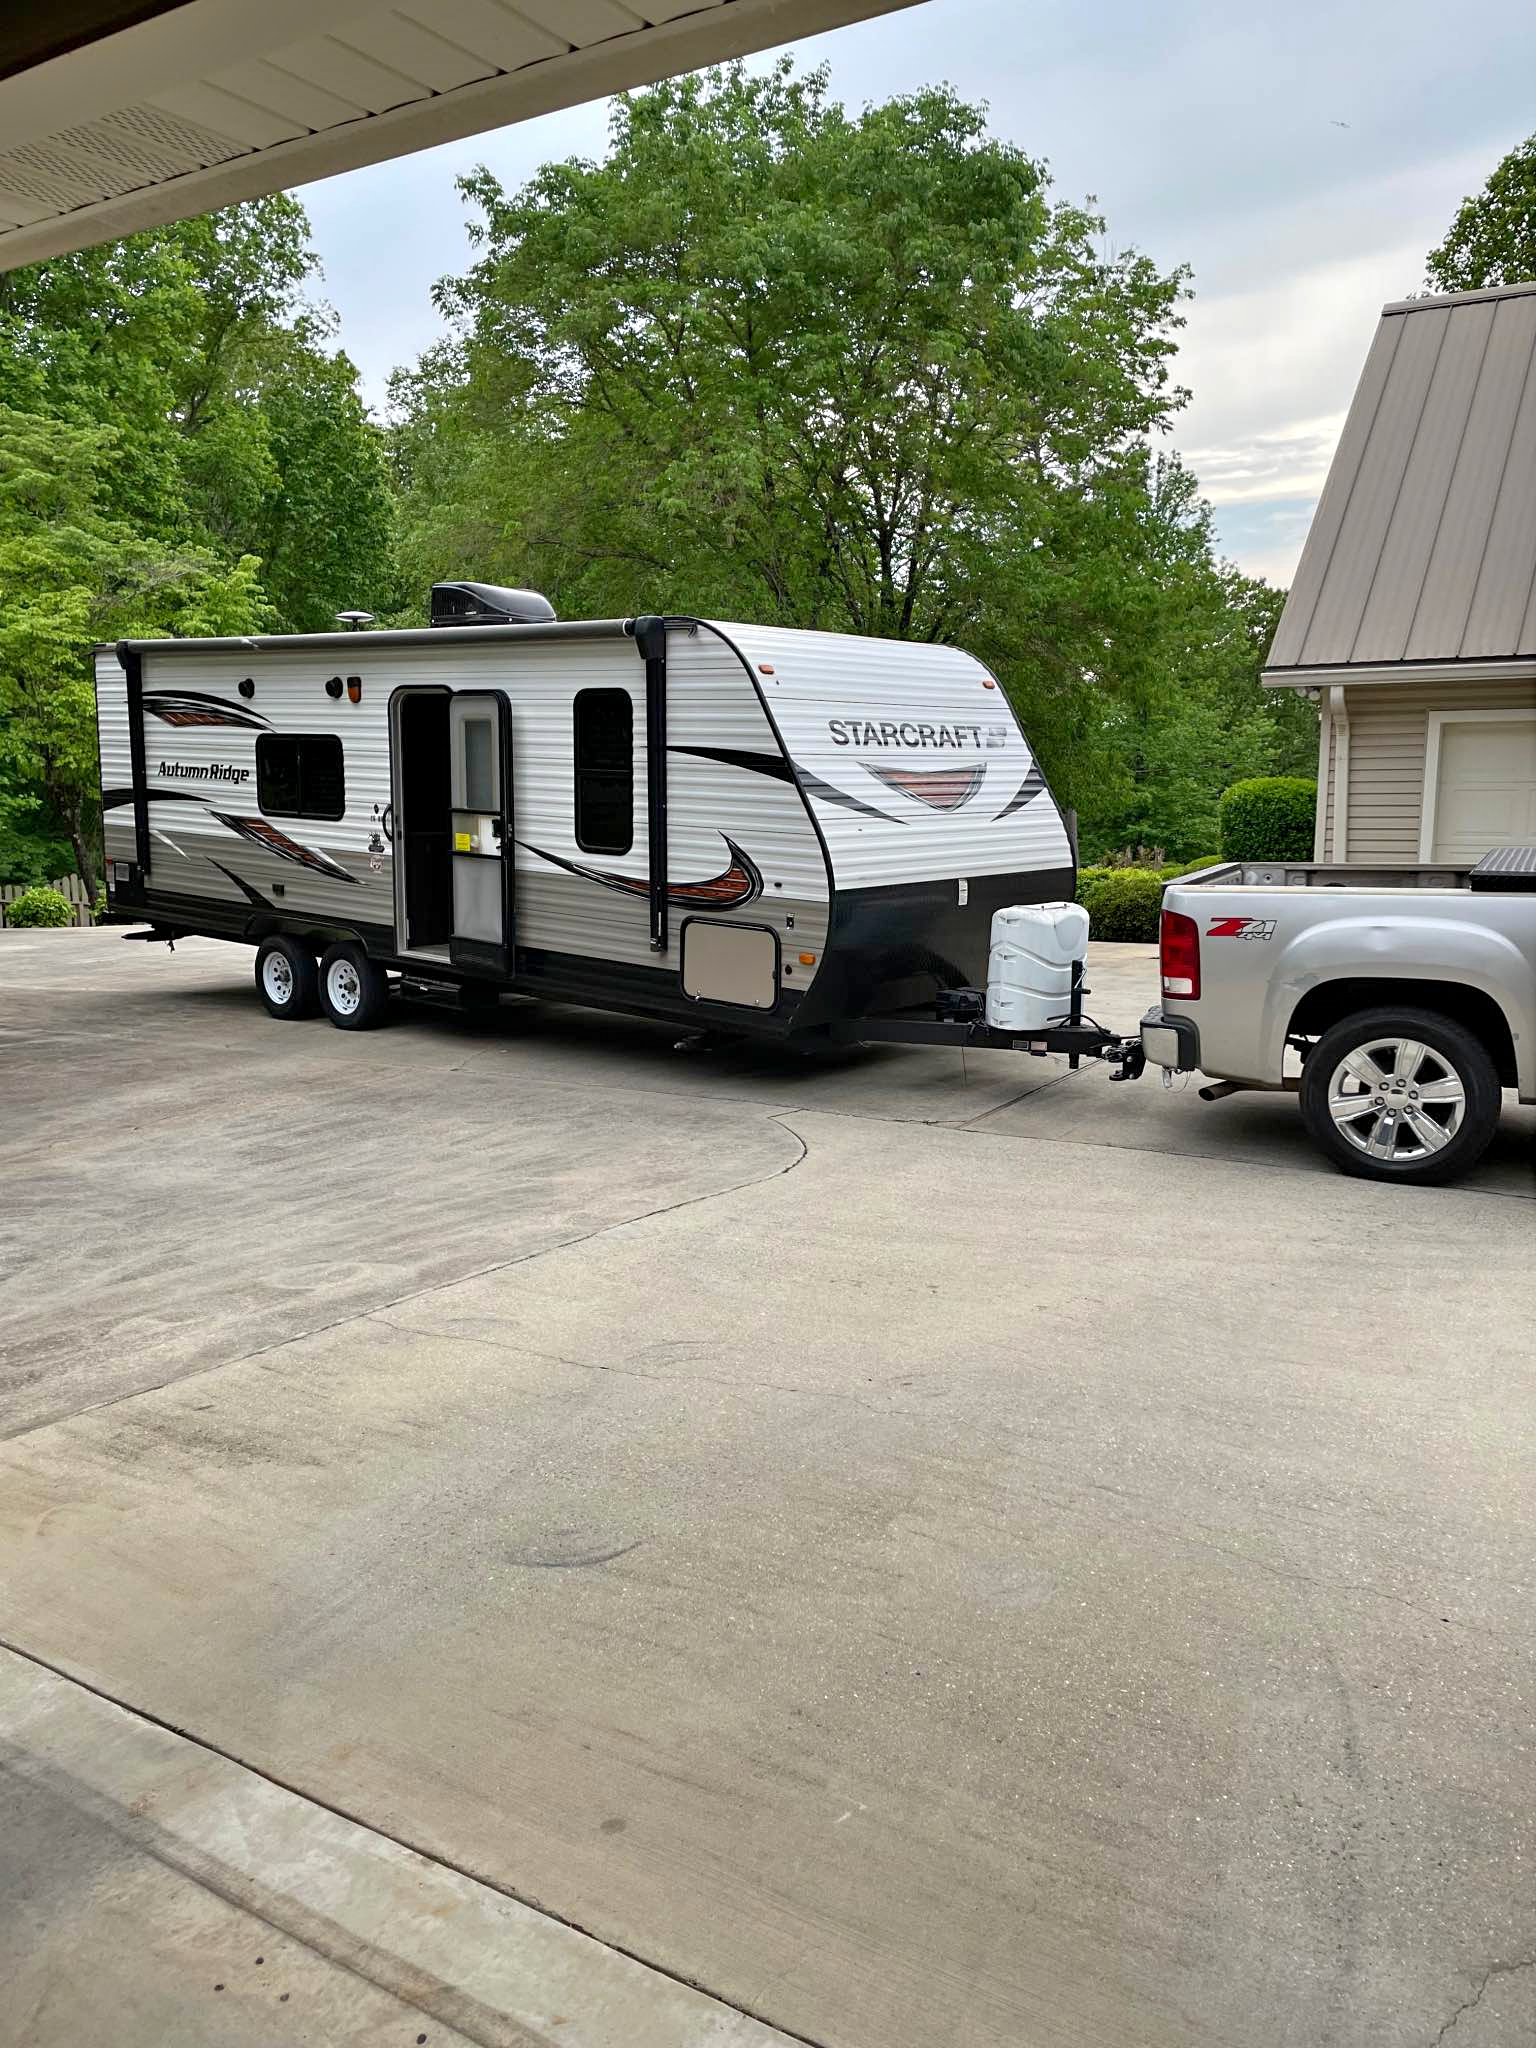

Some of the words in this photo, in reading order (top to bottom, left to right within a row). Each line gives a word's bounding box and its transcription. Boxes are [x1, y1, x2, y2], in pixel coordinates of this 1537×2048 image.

[828, 719, 981, 749] STARCRAFT
[158, 761, 208, 779] Autumn
[209, 763, 250, 784] Ridge
[1205, 917, 1277, 937] Z71
